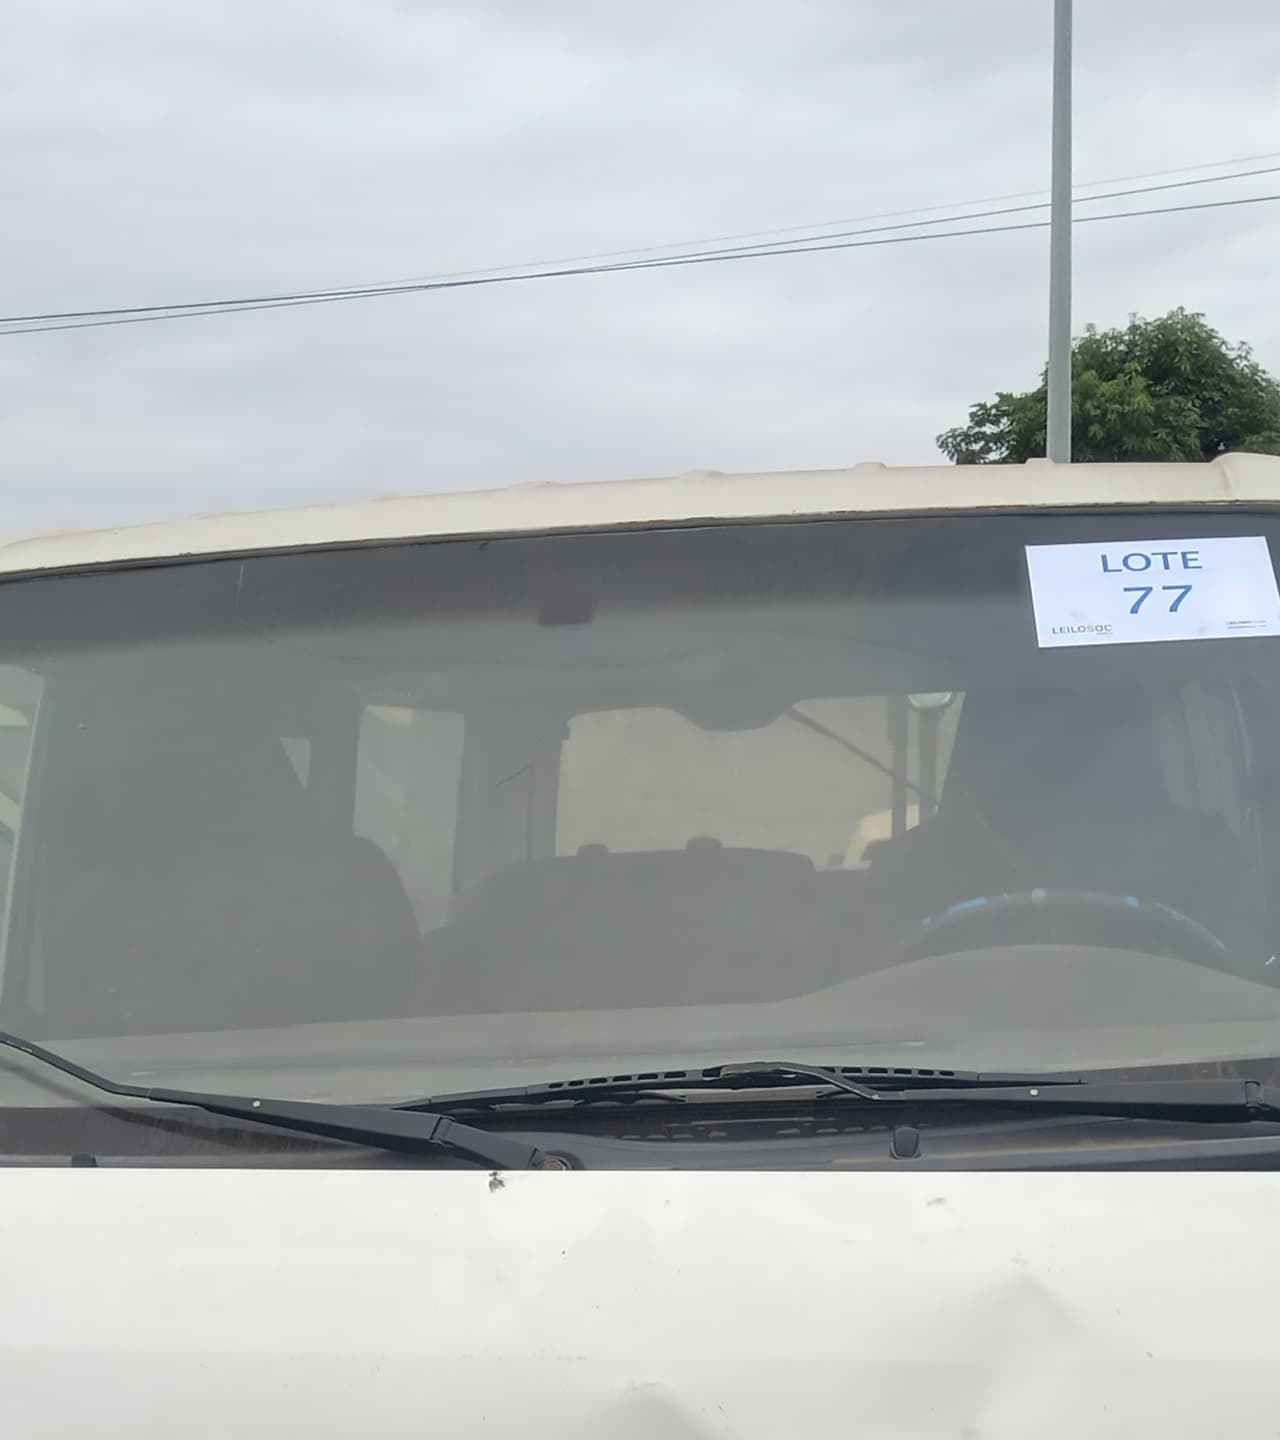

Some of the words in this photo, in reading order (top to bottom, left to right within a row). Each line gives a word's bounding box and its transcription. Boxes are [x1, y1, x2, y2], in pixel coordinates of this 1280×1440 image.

[1100, 550, 1203, 573] LOTE
[1123, 584, 1193, 615] 77
[1051, 624, 1113, 635] LEILOSOC
